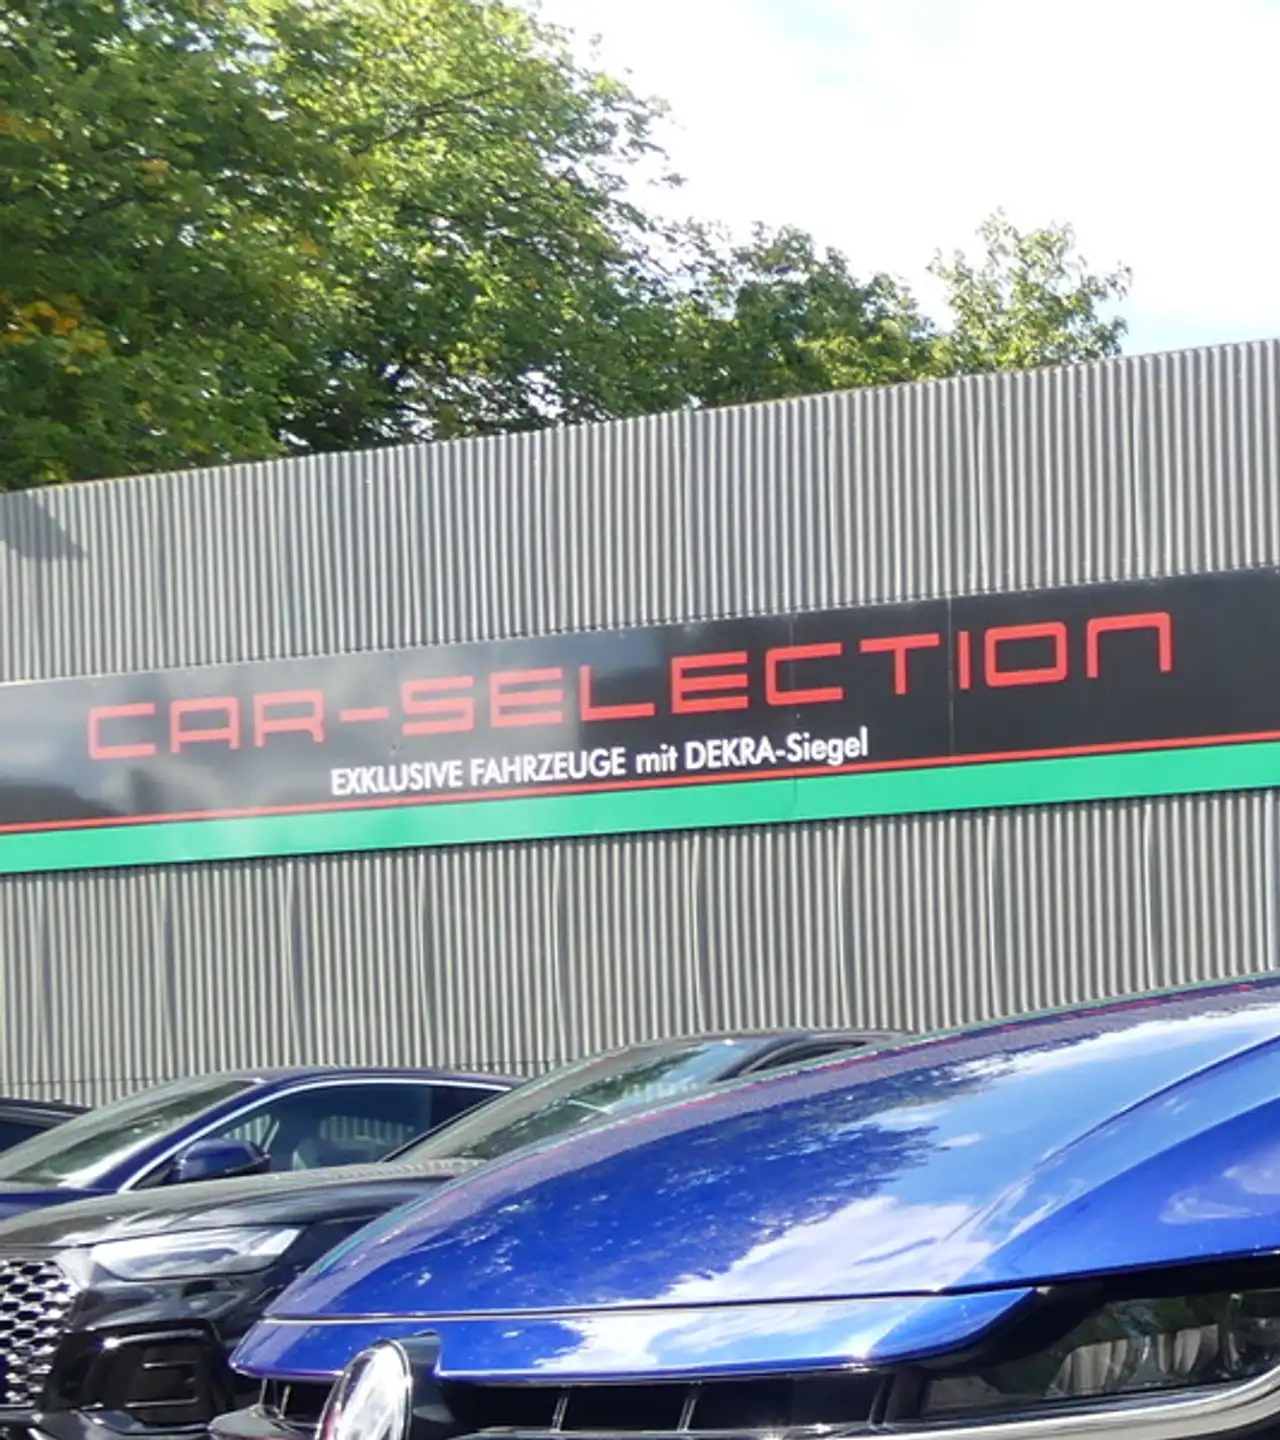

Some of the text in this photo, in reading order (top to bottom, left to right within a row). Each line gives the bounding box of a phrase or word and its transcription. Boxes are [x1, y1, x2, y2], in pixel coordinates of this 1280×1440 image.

[86, 611, 1172, 760] CAR-SELECTION
[330, 727, 869, 796] EXKLUSIVE FAHRZEUGE mit DEKRA-Siegel
